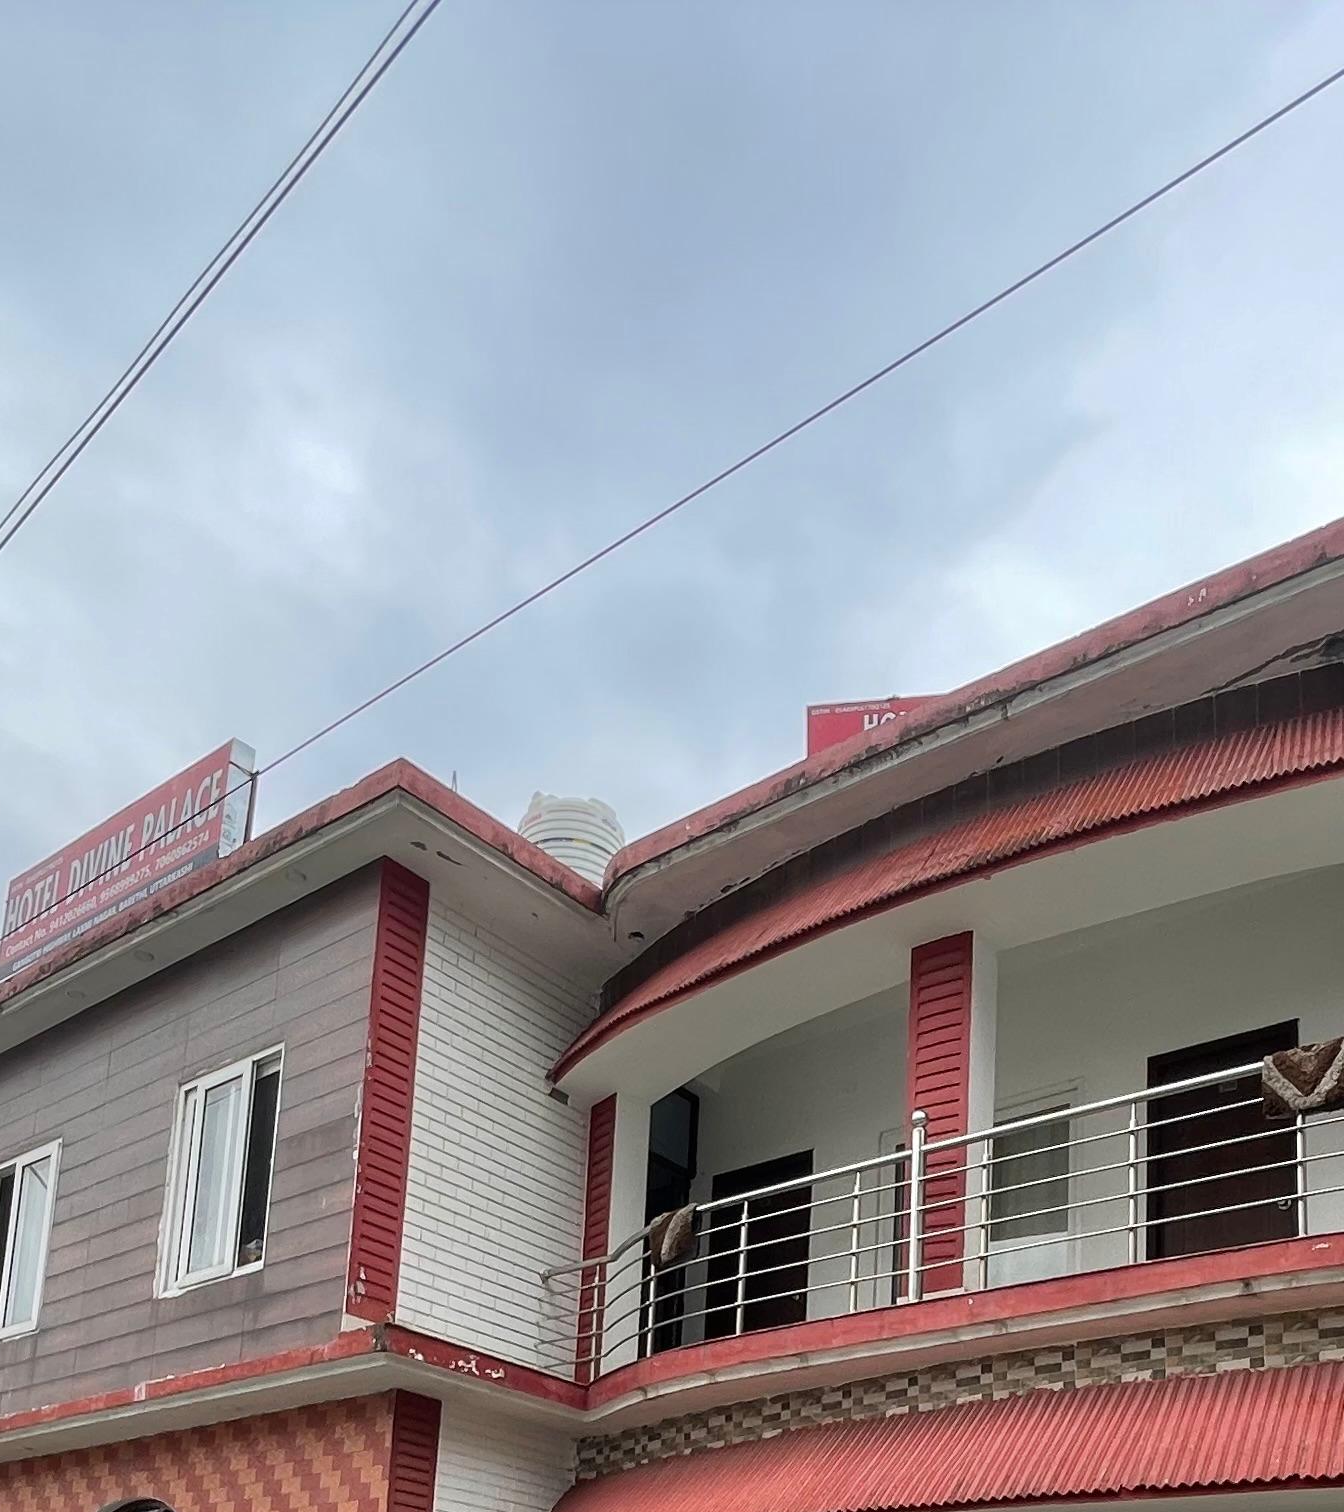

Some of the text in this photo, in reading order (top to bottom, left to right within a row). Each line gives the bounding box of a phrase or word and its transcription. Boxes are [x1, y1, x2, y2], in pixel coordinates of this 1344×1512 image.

[3, 870, 60, 941] HOTEL
[65, 824, 135, 905] DIVINE
[139, 768, 223, 862] PALACE
